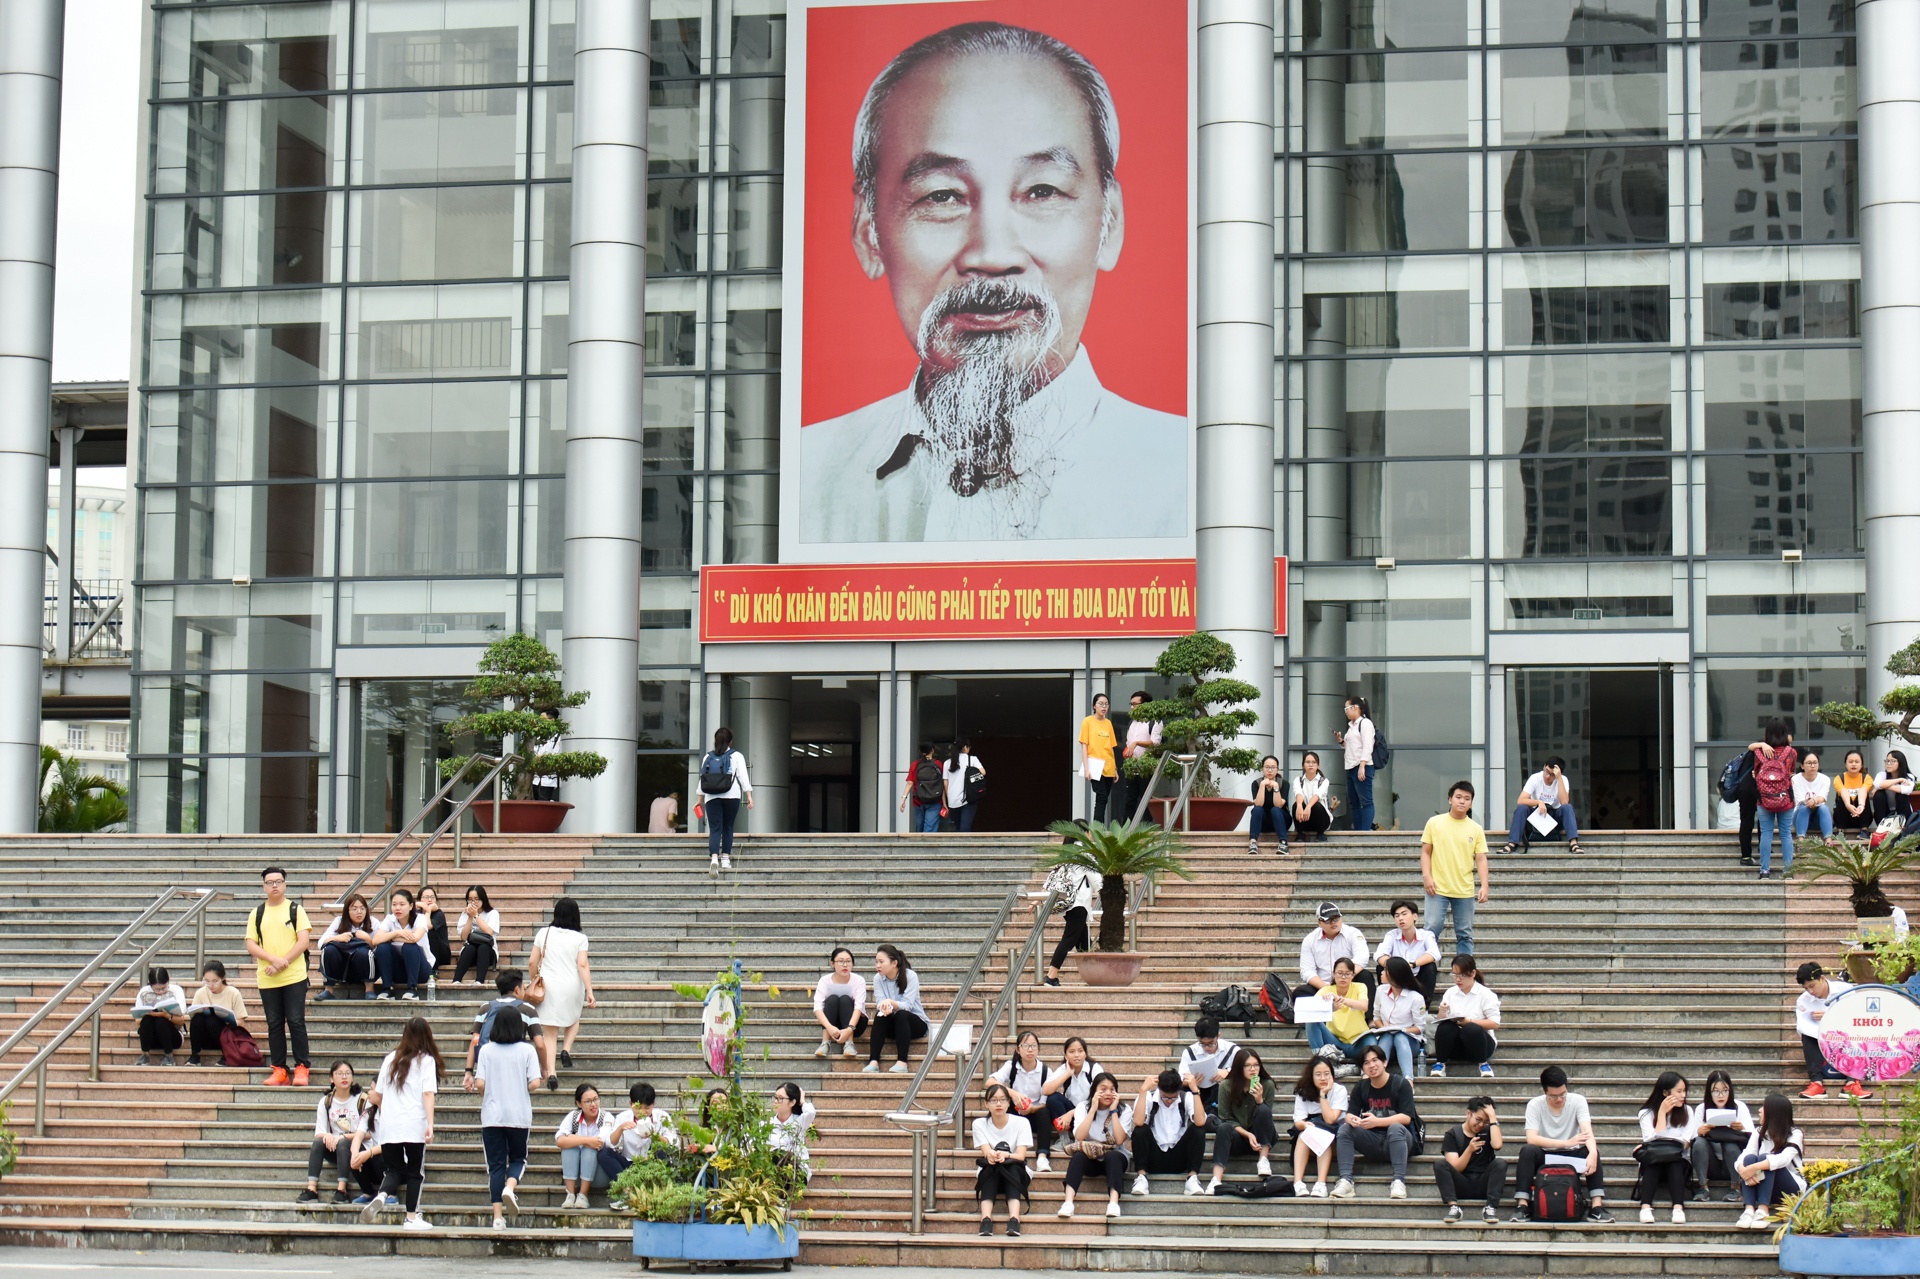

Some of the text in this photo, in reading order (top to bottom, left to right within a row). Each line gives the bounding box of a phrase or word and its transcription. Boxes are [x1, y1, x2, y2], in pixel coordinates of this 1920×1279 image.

[730, 587, 750, 624] DÙ
[753, 586, 783, 624] KHÓ
[786, 585, 827, 623] KHĂN
[829, 580, 860, 622] ĐẾN
[863, 584, 893, 622] ĐÂU
[896, 584, 937, 622] CŨNG
[940, 577, 975, 621] PHẢI
[978, 578, 1011, 621] TIẾP
[1014, 588, 1042, 627] TỤC
[1046, 588, 1069, 619] THI
[1073, 587, 1104, 619] ĐUA
[1107, 587, 1137, 625] DẠY
[1140, 576, 1167, 618] TỐT
[1170, 580, 1190, 618] VÀ
[1575, 611, 1600, 620] EXIT
[1852, 1015, 1894, 1027] KHỐI 9
